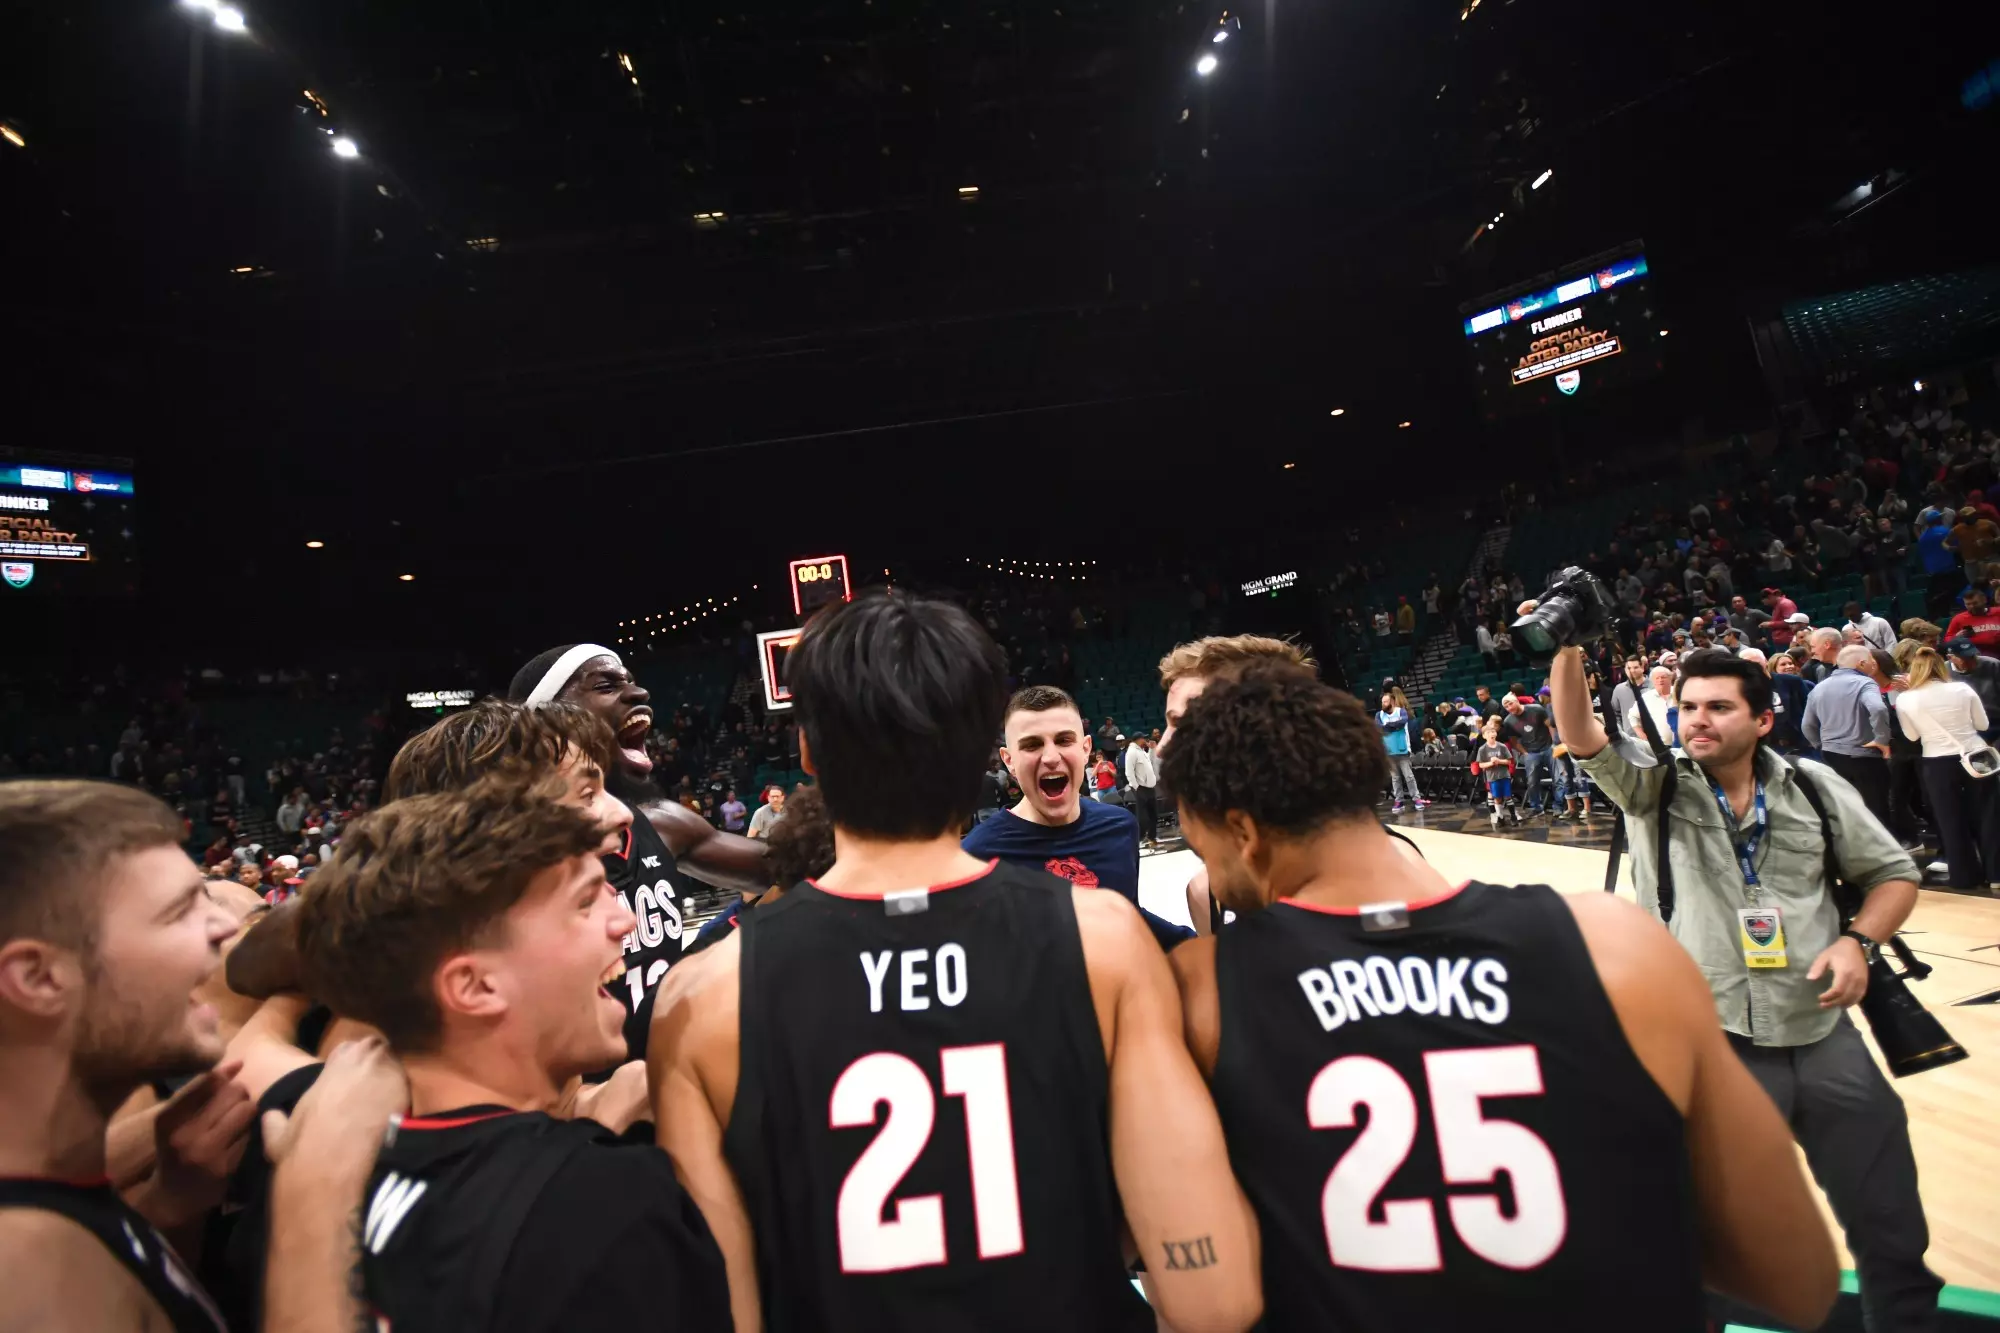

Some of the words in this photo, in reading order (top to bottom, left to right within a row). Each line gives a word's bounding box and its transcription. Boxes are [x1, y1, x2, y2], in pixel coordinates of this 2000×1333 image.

[1530, 325, 1591, 351] OFFICIAL
[1531, 307, 1582, 334] FLANKER
[1519, 346, 1560, 368] AFTER
[1563, 329, 1608, 353] PARTY
[18, 530, 77, 543] PARTY
[1241, 579, 1264, 591] MGM
[1264, 571, 1298, 586] GRAND
[406, 692, 436, 701] MGM
[436, 690, 475, 700] GRAND
[859, 942, 968, 1012] YEO
[1298, 955, 1510, 1032] BROOKS
[828, 1040, 1025, 1274] 21
[1306, 1043, 1568, 1272] 25
[1162, 1236, 1218, 1271] XXII
